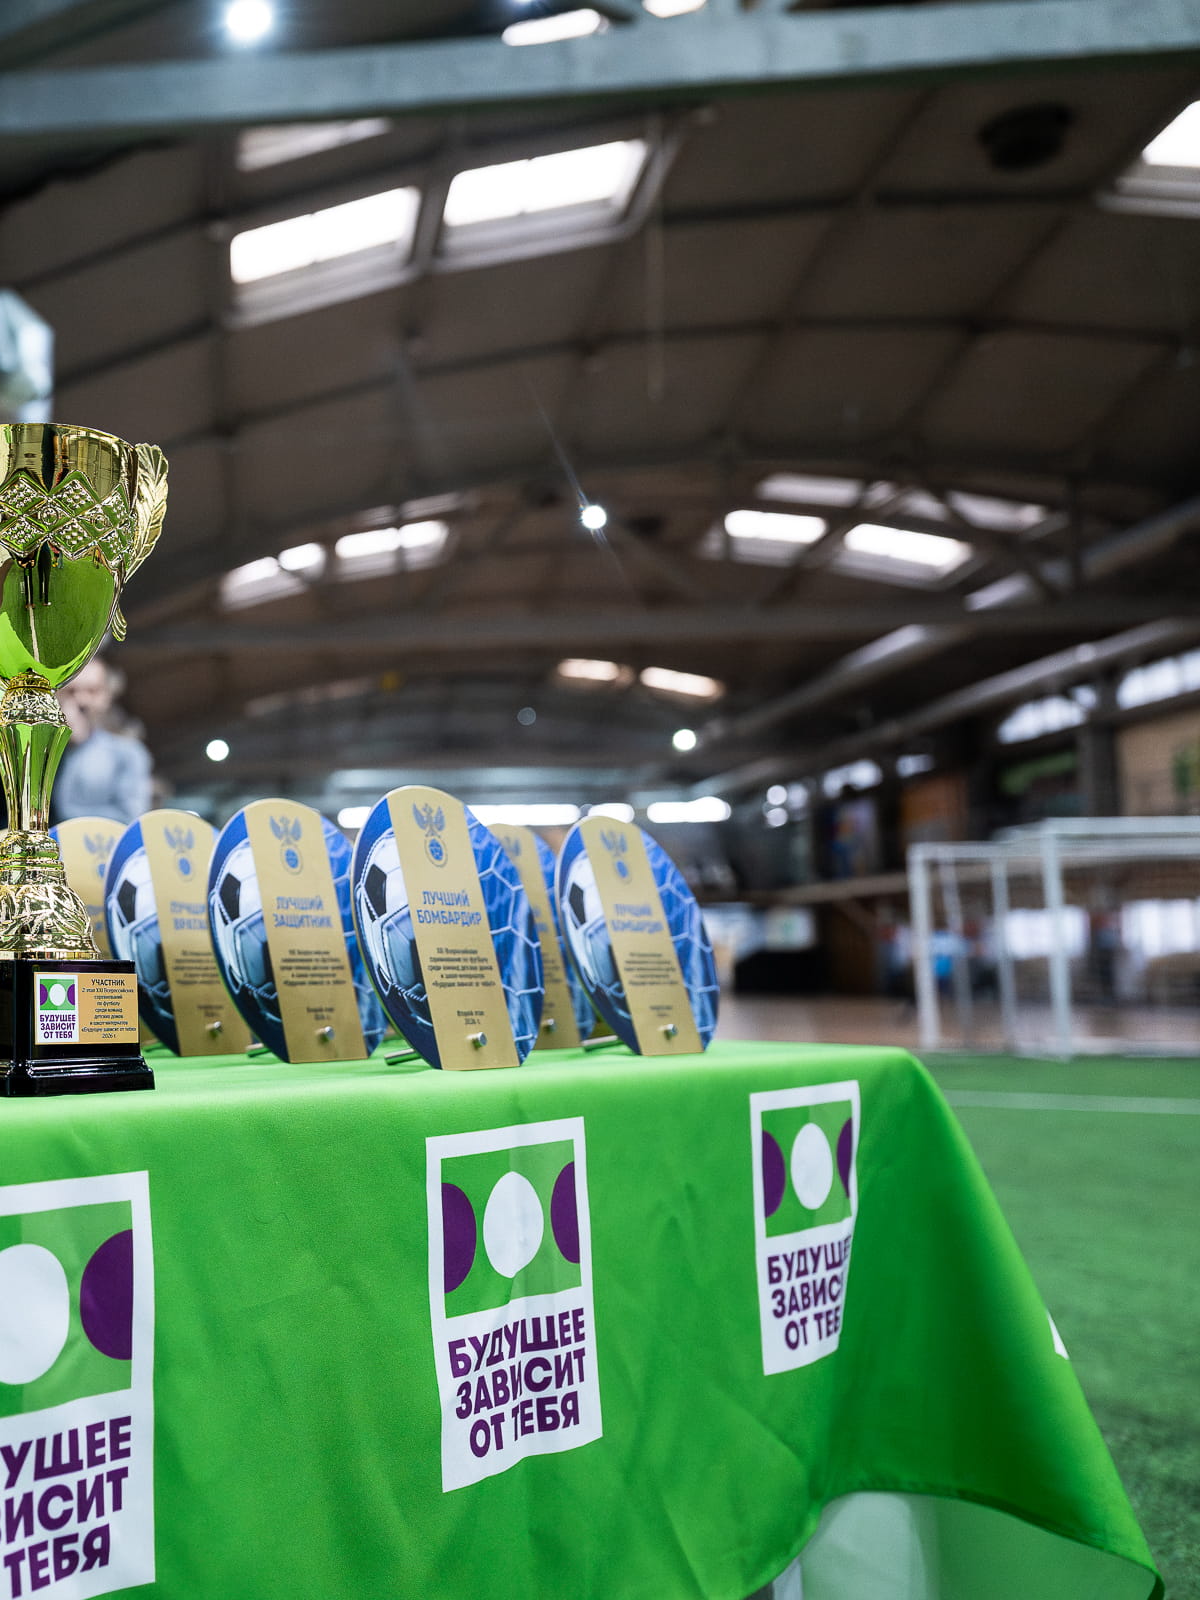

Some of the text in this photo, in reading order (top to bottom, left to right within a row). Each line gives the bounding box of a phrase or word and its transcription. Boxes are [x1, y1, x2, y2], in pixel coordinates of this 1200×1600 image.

[416, 909, 482, 927] БОМБАРДИР
[422, 890, 471, 907] ЛУЧШИЙ
[39, 1014, 76, 1022] БУДУЩЕЕ
[40, 1022, 76, 1030] ЗАВИСИТ
[43, 1031, 73, 1039] ОТ ТЕБЯ
[767, 1233, 852, 1285] БУДУЩЕ
[771, 1271, 844, 1319] ЗАВИС
[448, 1307, 586, 1379] БУДУЩЕЕ
[784, 1316, 808, 1351] ОТ
[455, 1346, 586, 1420] ЗАВИСИТ
[469, 1390, 580, 1458] ОТ ТЕБЯ
[3, 1523, 111, 1600] ТЕБЯ
